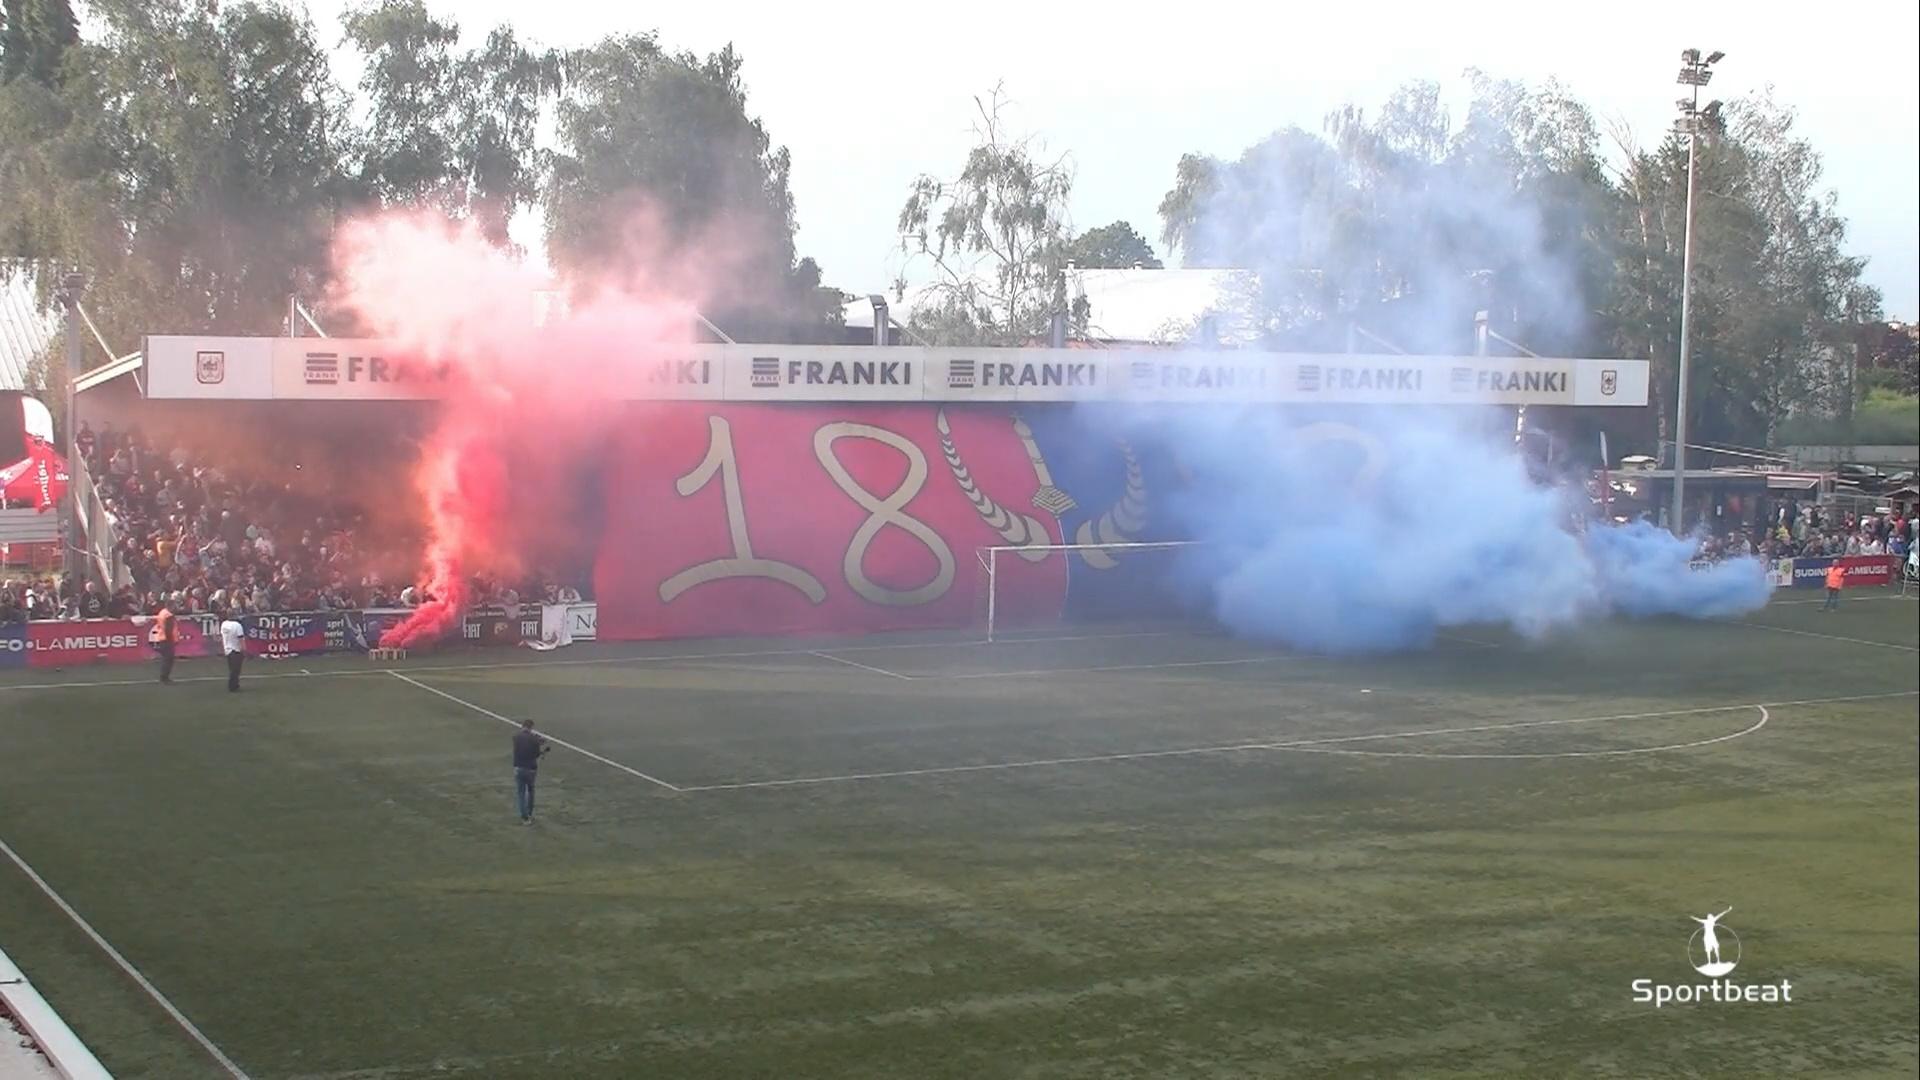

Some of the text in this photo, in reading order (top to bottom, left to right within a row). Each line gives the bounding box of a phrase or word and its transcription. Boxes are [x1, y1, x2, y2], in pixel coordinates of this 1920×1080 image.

[788, 361, 912, 386] FRANKI
[981, 362, 1096, 387] FRANKI
[1160, 364, 1267, 390] FRANKI
[1326, 367, 1422, 391] FRANKI
[1477, 371, 1567, 393] FRANKI
[248, 626, 306, 641] SERGIO
[464, 622, 482, 639] FIAT
[520, 620, 539, 636] FIAT
